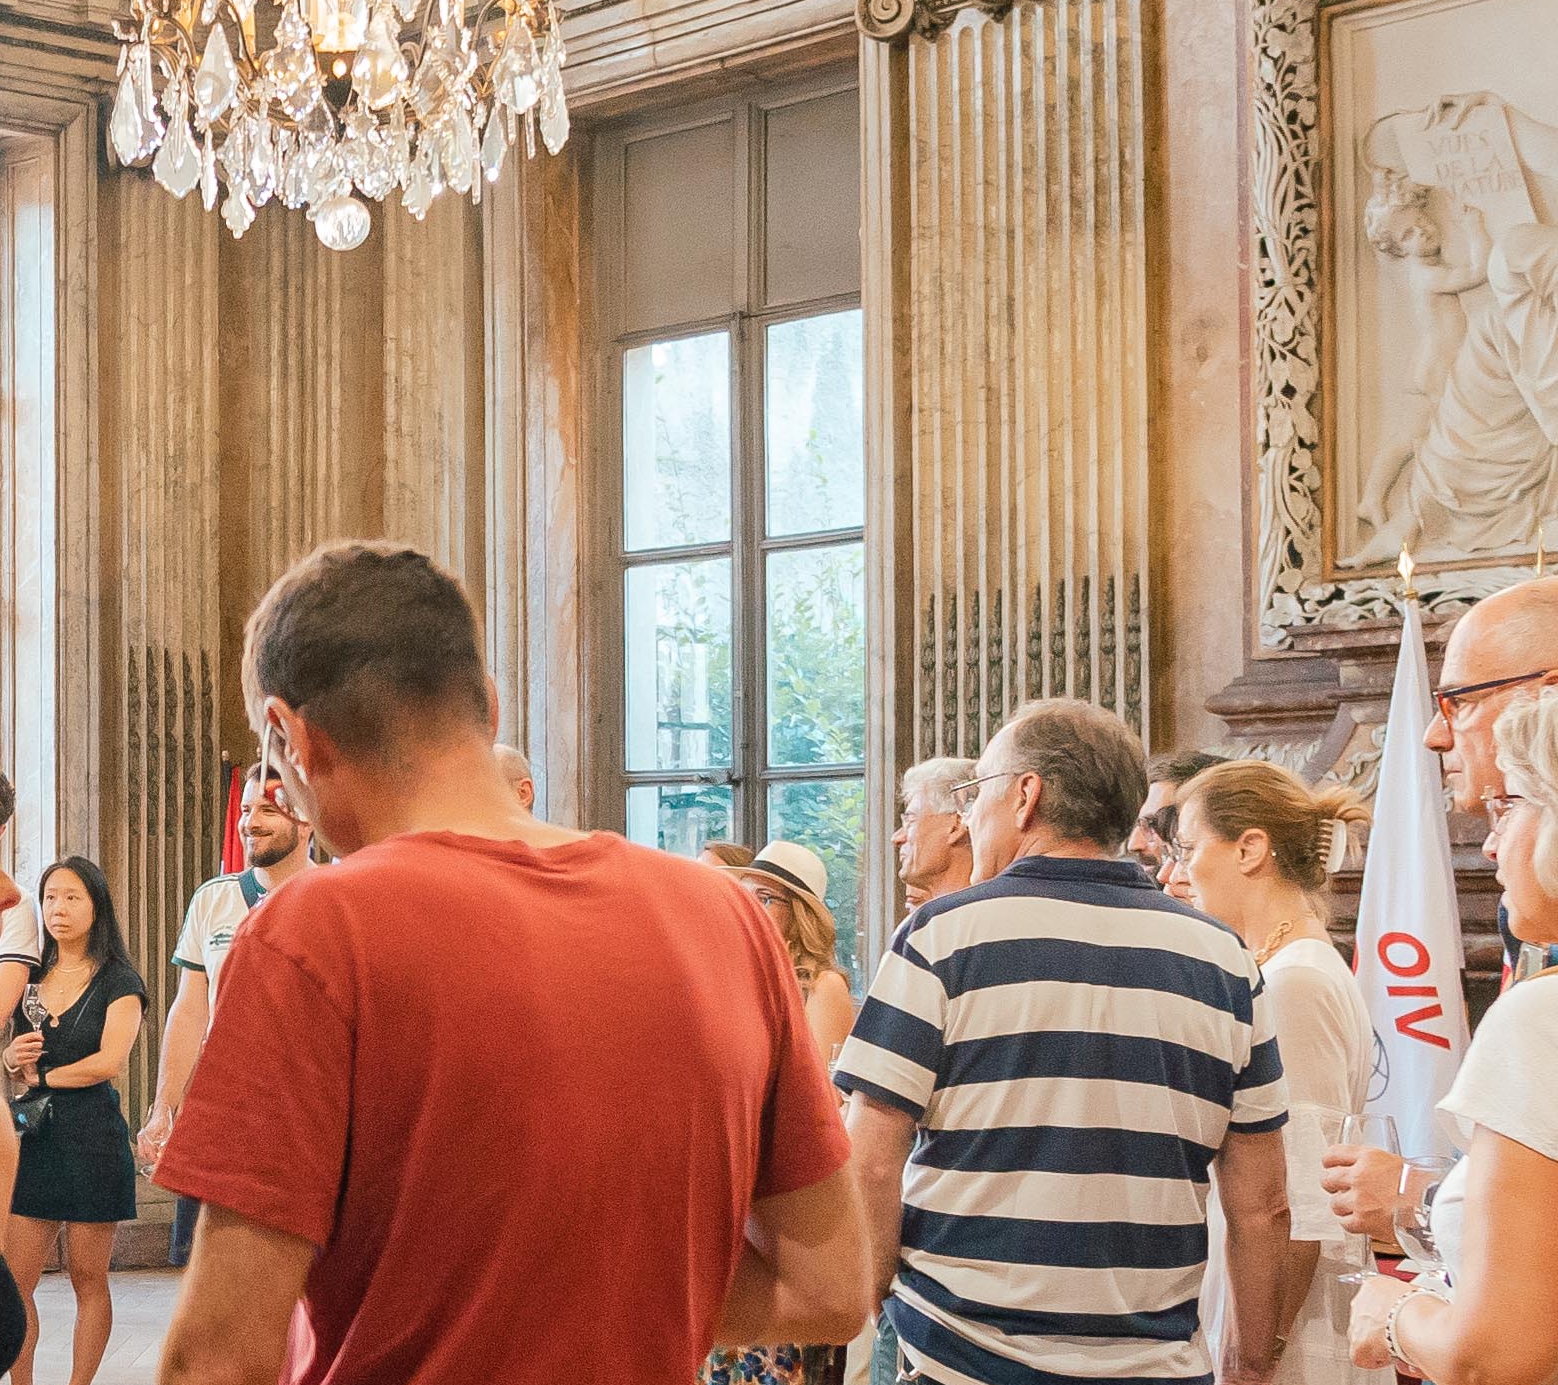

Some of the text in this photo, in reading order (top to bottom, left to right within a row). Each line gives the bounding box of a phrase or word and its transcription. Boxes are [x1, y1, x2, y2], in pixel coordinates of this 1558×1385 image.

[1435, 152, 1504, 181] DE LA
[1376, 931, 1452, 1051] OIV
